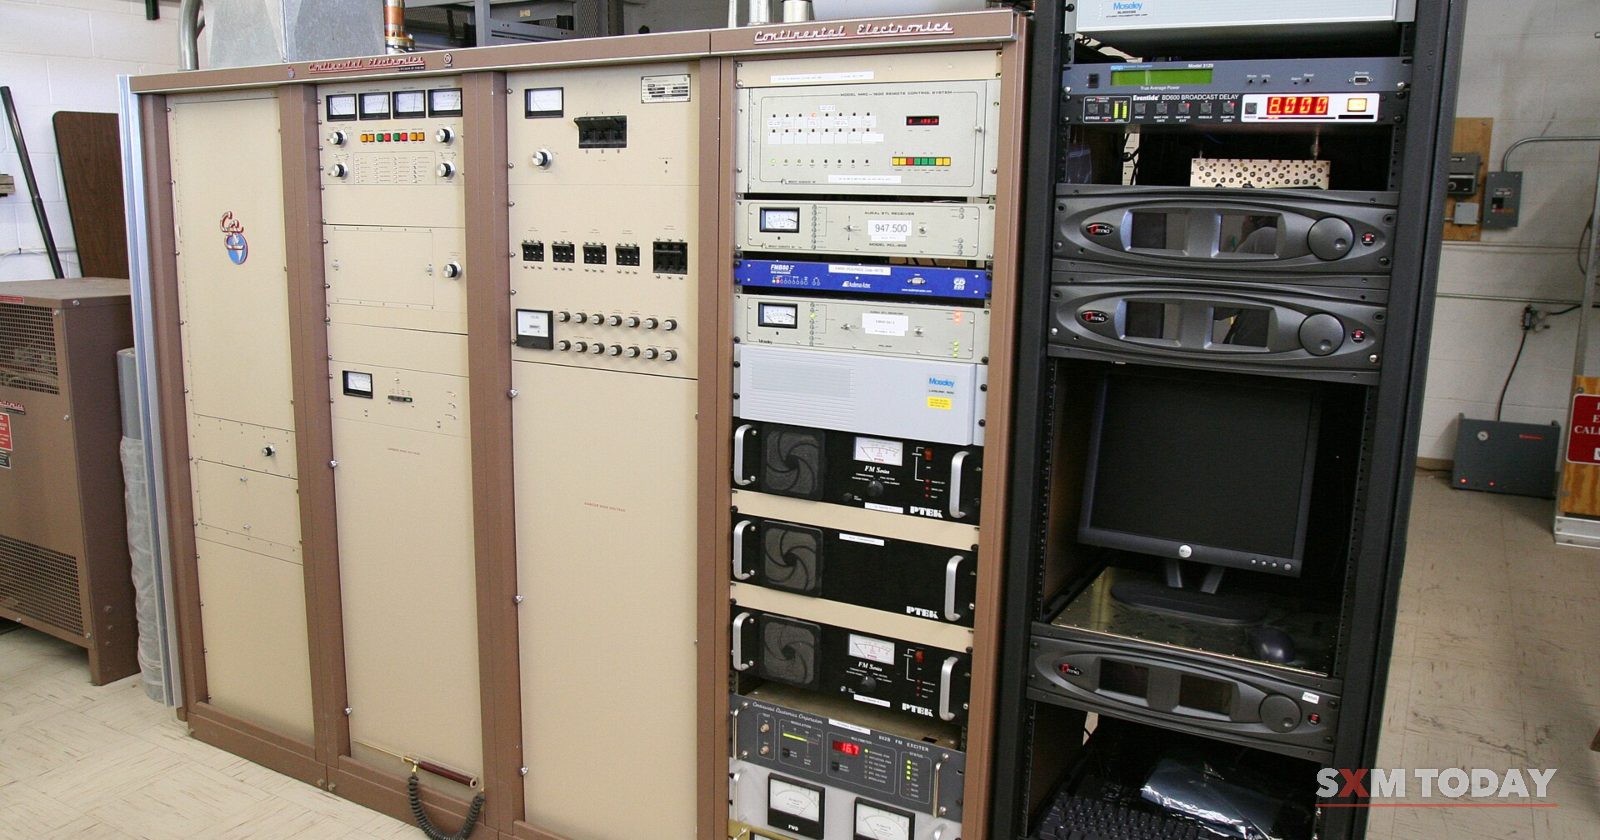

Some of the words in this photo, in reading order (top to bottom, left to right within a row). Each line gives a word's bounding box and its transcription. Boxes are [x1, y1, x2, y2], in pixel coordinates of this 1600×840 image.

[754, 26, 846, 42] Continental
[857, 21, 953, 36] Electronics
[875, 223, 908, 233] 947.500
[864, 465, 875, 473] FM
[910, 505, 943, 519] PTEK
[906, 606, 939, 619] PTEK
[858, 661, 869, 669] FM
[902, 702, 933, 717] PTEK
